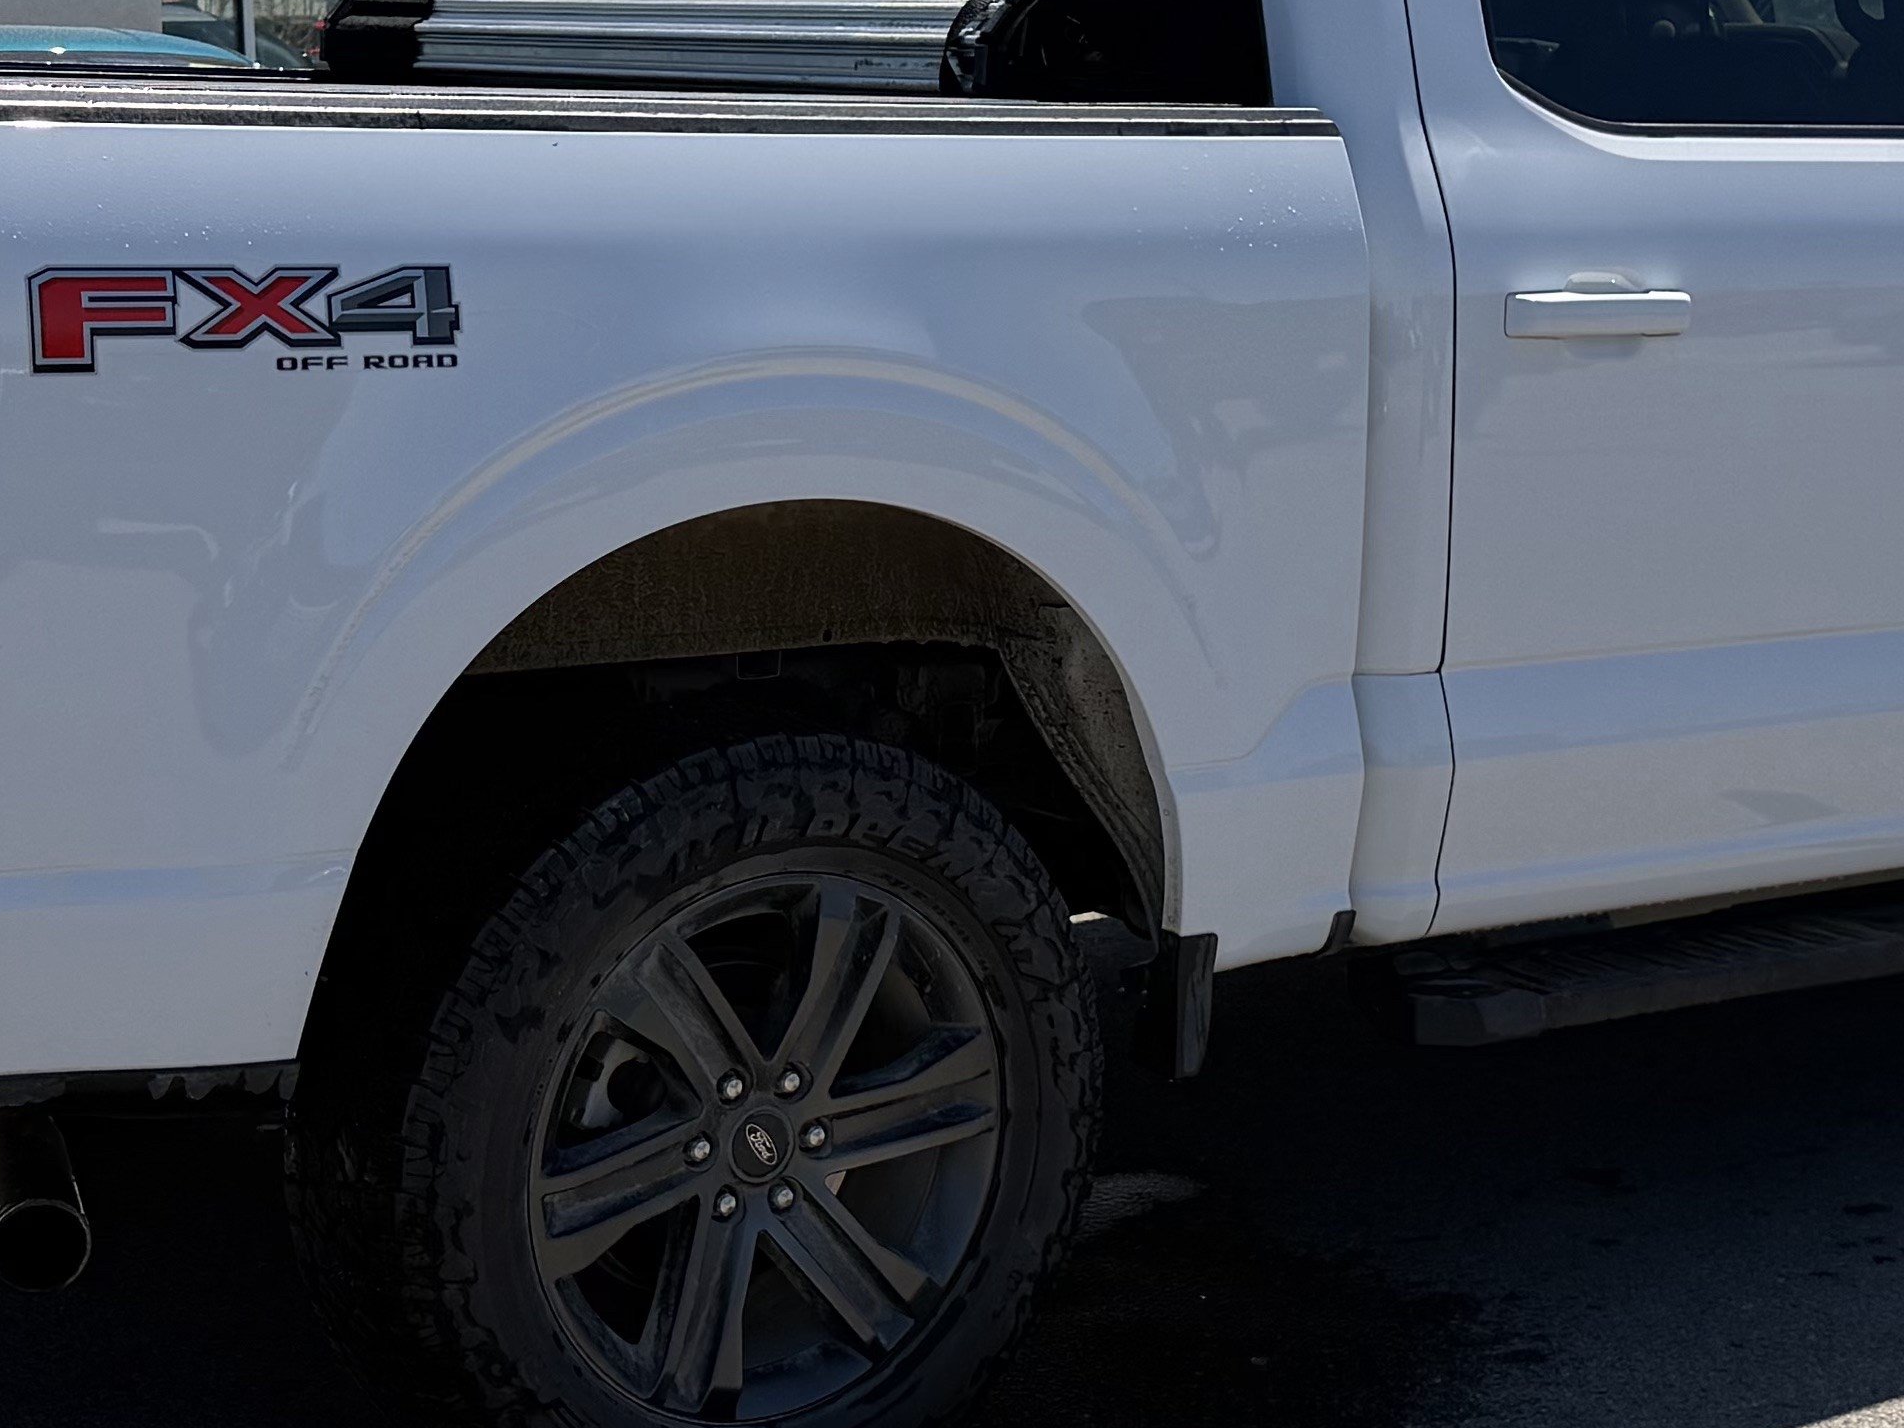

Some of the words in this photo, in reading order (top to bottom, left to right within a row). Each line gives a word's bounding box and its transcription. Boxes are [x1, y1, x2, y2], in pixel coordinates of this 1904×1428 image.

[26, 263, 460, 375] FX4
[276, 355, 348, 371] OFF
[363, 353, 458, 370] ROAD
